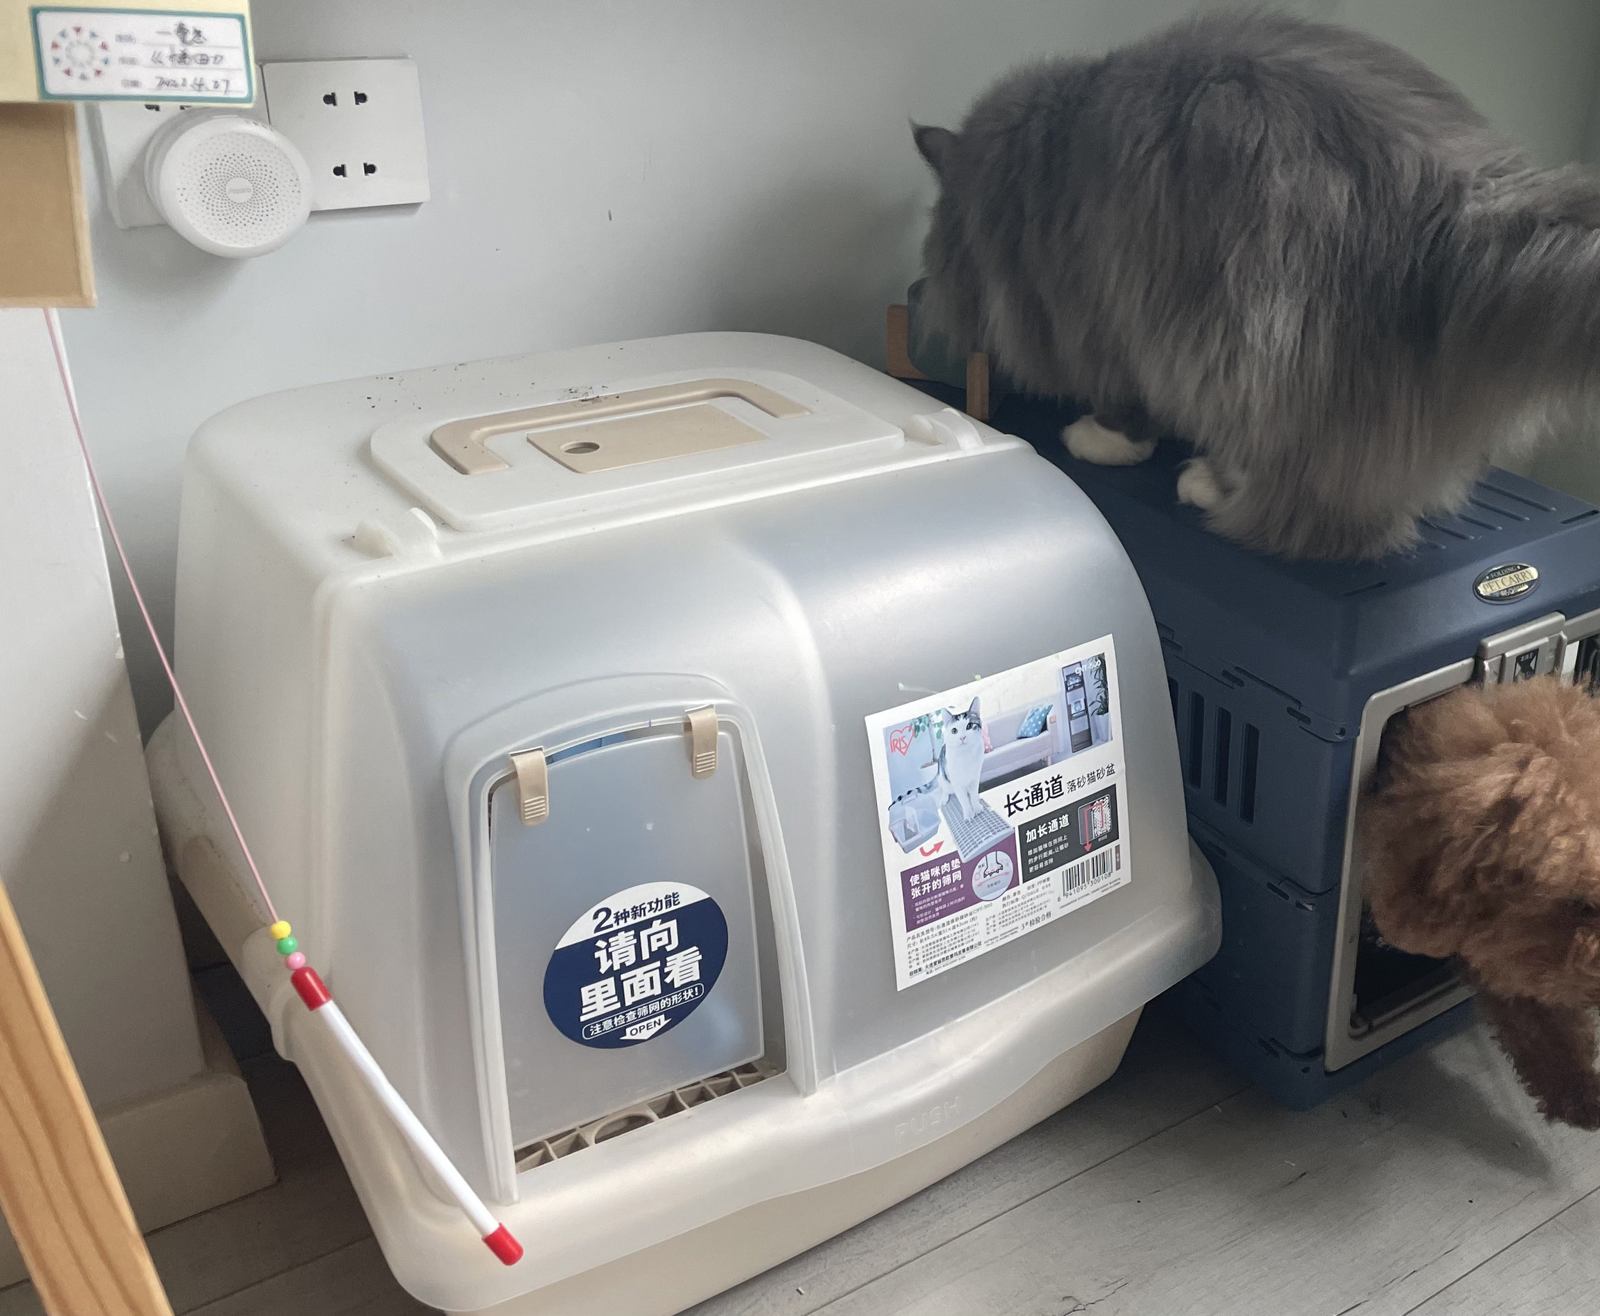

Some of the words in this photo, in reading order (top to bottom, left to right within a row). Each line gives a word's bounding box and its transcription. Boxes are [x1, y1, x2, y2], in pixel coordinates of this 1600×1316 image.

[1003, 774, 1065, 818] 长通道
[1066, 763, 1116, 794] 落砂猫砂盆
[1025, 814, 1070, 843] 加长通道
[909, 858, 961, 887] 使猫咪肉垫
[911, 870, 962, 900] 张开的筛网
[592, 892, 681, 934] 2种新功能
[594, 919, 680, 975] 请向
[580, 946, 703, 1022] 里面看
[629, 1018, 662, 1037] OPEN
